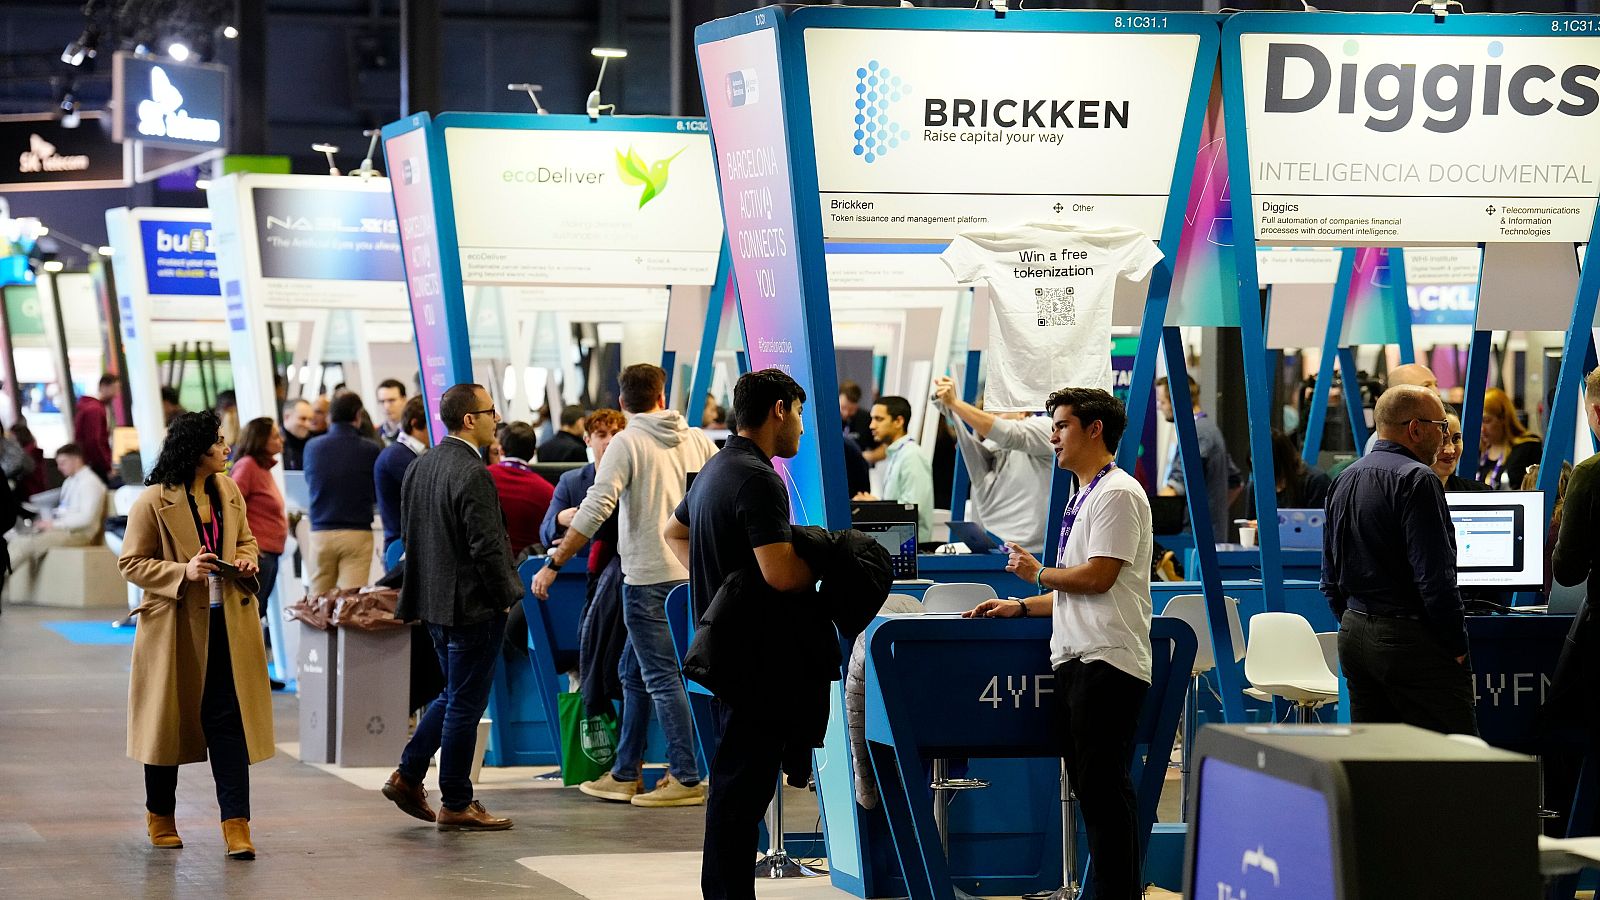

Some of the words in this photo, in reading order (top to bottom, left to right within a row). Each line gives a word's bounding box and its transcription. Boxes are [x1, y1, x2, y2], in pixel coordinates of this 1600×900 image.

[1114, 17, 1168, 29] 8.1C31.1
[1263, 39, 1600, 133] Diggics
[923, 98, 1130, 129] BRICKKEN
[923, 129, 957, 142] Raise
[960, 130, 1003, 145] capital
[1006, 132, 1036, 146] your
[1038, 133, 1065, 146] way
[726, 146, 779, 181] BARCELONA
[502, 166, 606, 186] ecoDeliver
[1258, 161, 1421, 183] INTELIGENCIA
[1428, 163, 1593, 185] DOCUMENTAL
[830, 199, 874, 210] Brickken
[1072, 203, 1095, 213] Other
[1262, 201, 1299, 214] Diggics
[1501, 206, 1581, 215] Telecommunications
[830, 213, 854, 223] Token
[855, 214, 889, 223] issuance
[890, 215, 905, 223] and
[906, 215, 956, 225] management
[1261, 216, 1276, 224] Full
[1277, 217, 1318, 225] automation
[1319, 217, 1328, 225] of
[1329, 218, 1369, 227] companies
[1371, 217, 1402, 226] financial
[1500, 216, 1506, 225] &
[1508, 217, 1552, 226] Information
[1260, 227, 1299, 236] processes
[1301, 227, 1316, 235] with
[1317, 227, 1354, 236] document
[1500, 227, 1551, 238] Technologies
[738, 228, 787, 259] CONNECTS
[1019, 250, 1046, 263] Win
[1049, 252, 1058, 261] a
[1061, 248, 1088, 261] free
[1013, 265, 1094, 279] tokenization
[755, 268, 776, 298] YOU
[978, 674, 1055, 709] 4YF
